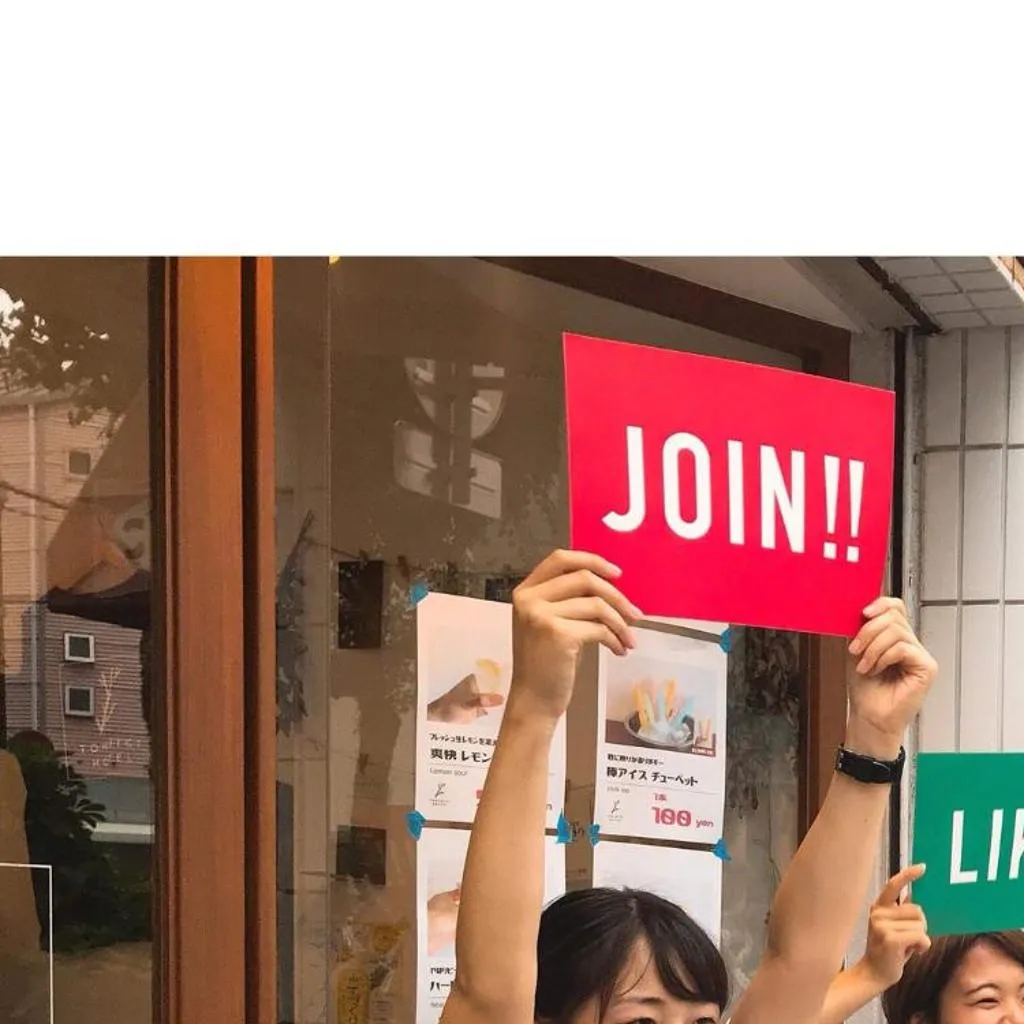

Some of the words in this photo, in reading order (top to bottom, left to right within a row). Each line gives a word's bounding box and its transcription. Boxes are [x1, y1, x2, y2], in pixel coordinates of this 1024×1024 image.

[601, 425, 865, 563] JOIN!!
[651, 806, 691, 827] 100
[696, 818, 714, 828] yen
